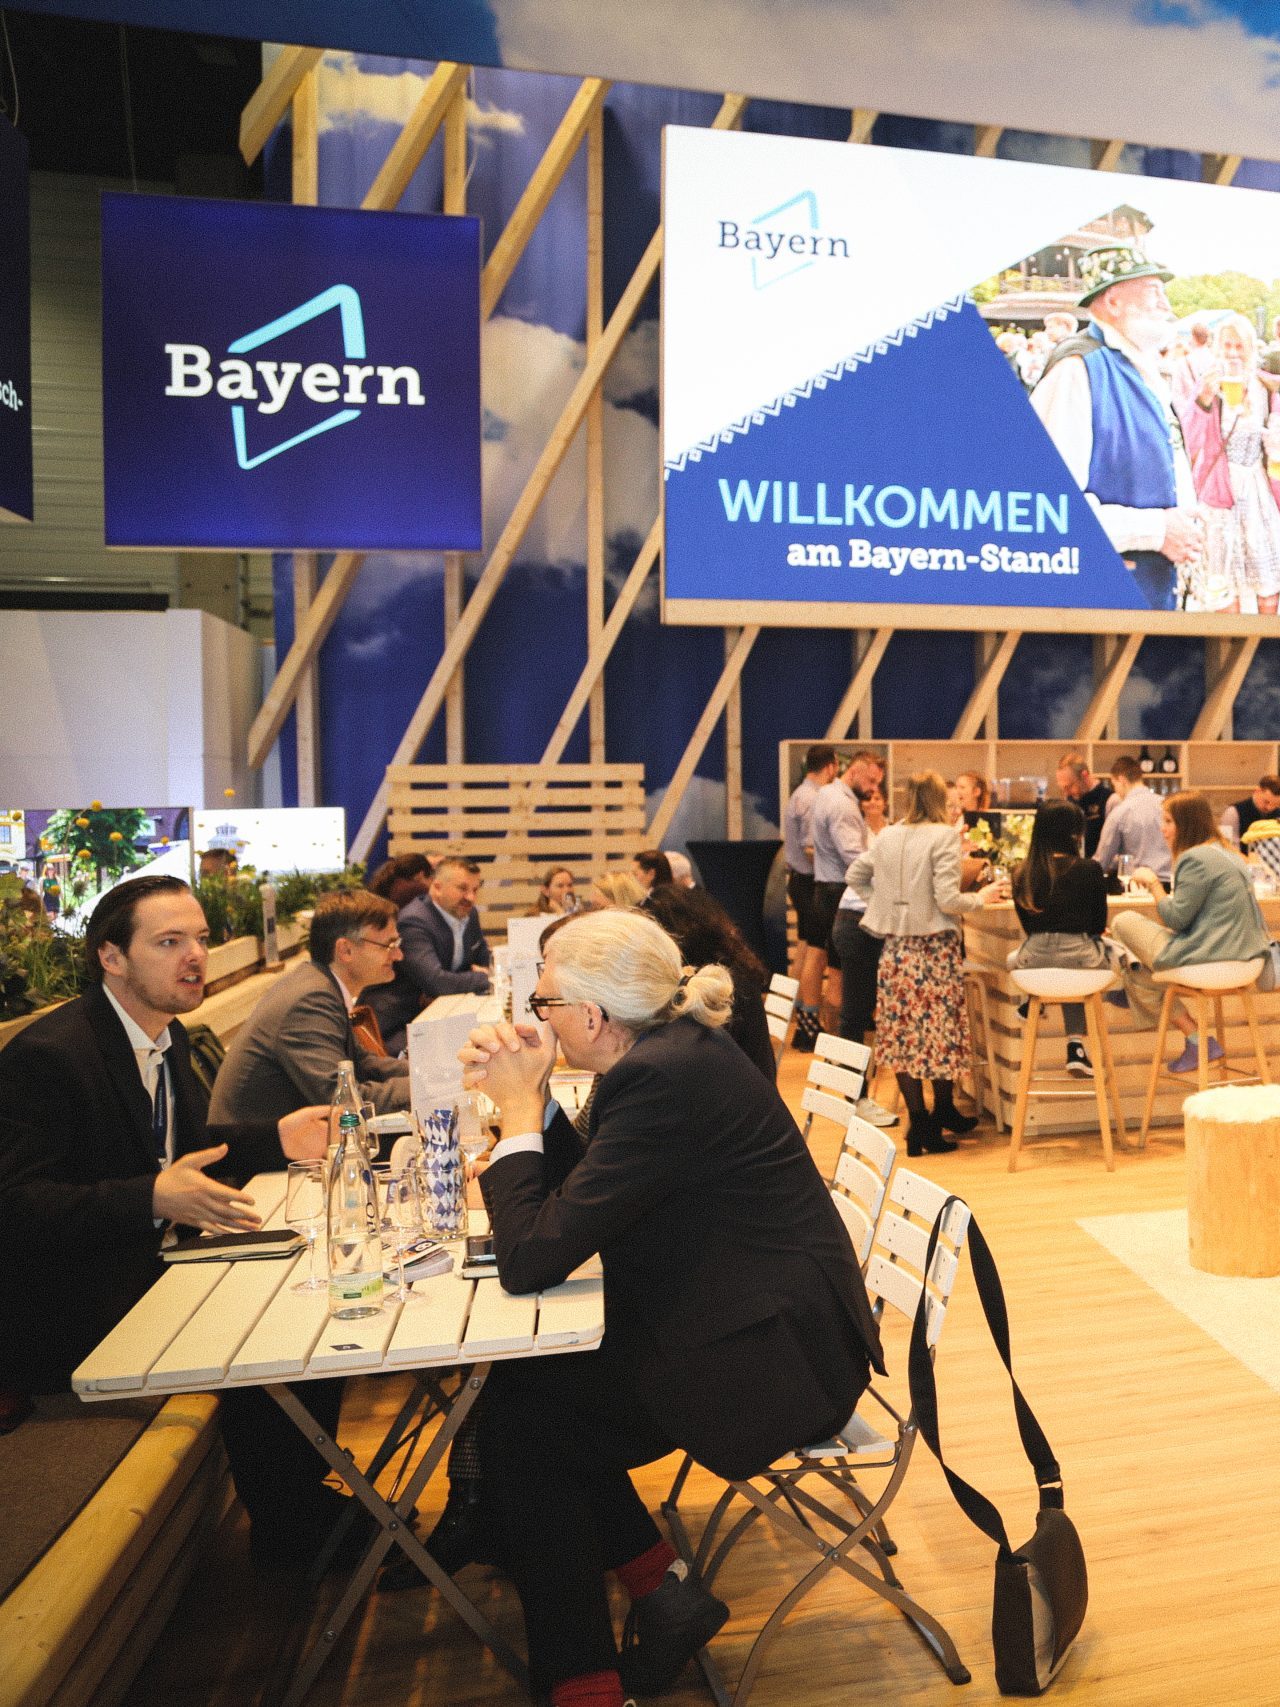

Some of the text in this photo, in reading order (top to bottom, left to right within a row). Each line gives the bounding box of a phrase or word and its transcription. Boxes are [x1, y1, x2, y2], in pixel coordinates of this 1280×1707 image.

[717, 220, 850, 259] Bayern
[165, 343, 426, 414] Bayern
[718, 478, 1069, 535] WILLKOMMEN
[786, 539, 1080, 576] am Bayern-Stand!
